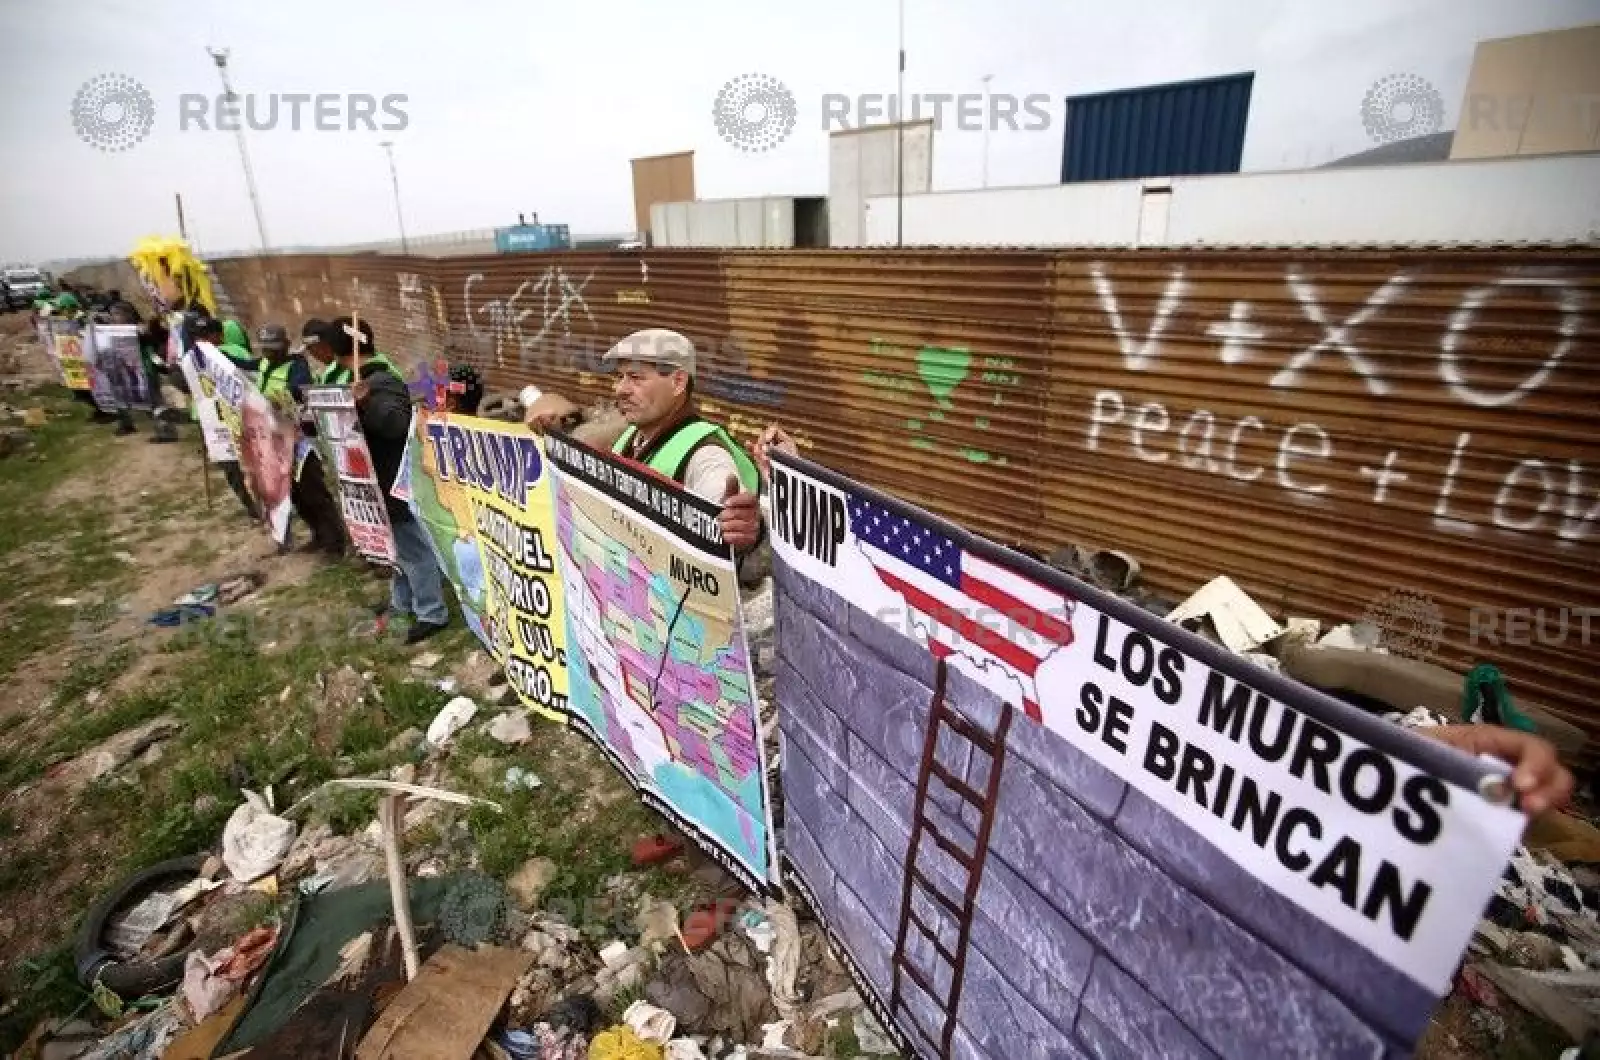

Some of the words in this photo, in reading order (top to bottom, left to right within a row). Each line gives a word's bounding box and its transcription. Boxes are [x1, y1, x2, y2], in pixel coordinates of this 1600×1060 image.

[426, 423, 543, 506] TRUMP
[1086, 391, 1332, 501] Peace
[669, 553, 719, 596] MURO
[1094, 615, 1185, 705] LOS
[1198, 671, 1450, 845] MUROS
[1076, 682, 1134, 754] SE
[1143, 721, 1432, 942] BRINCAN
